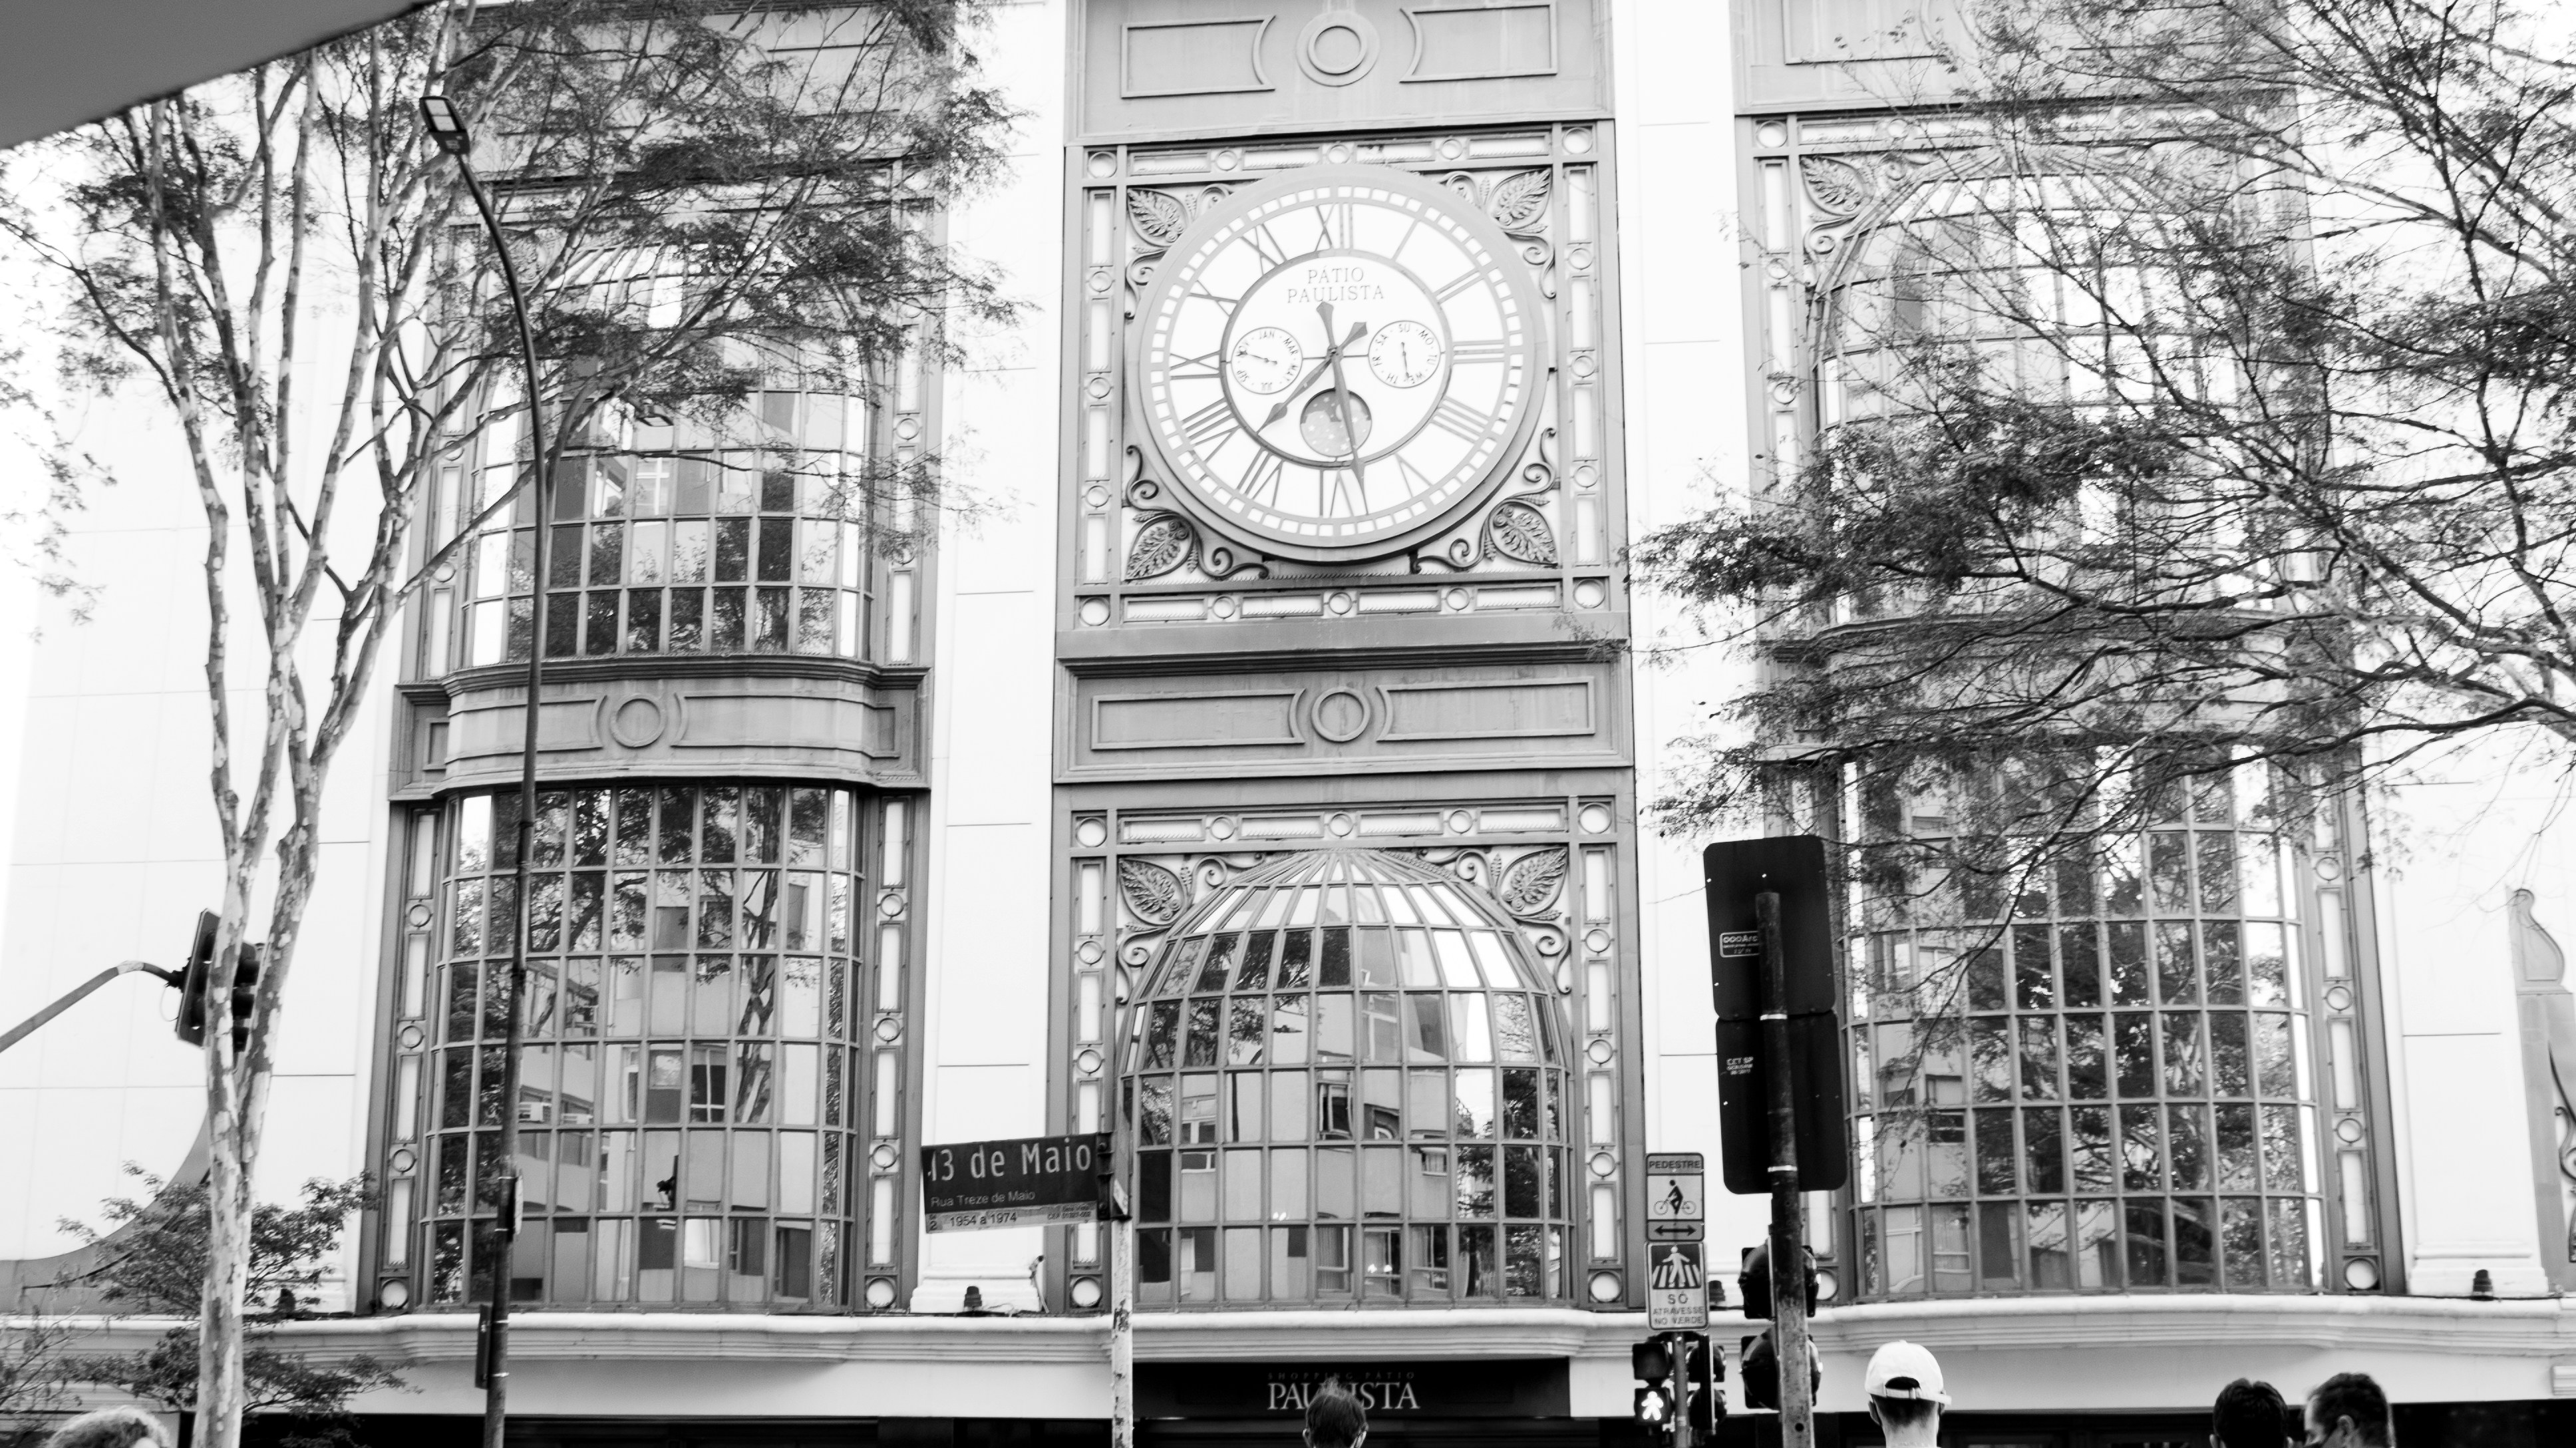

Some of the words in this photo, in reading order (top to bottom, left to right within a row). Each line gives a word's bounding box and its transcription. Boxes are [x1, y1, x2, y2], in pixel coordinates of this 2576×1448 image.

[1308, 266, 1364, 284] PÁTIO
[1287, 285, 1384, 303] PAULISTA
[1418, 329, 1434, 345] MO
[927, 1149, 954, 1181] 13
[970, 1145, 1005, 1179] de
[1021, 1137, 1092, 1176] Maio
[1649, 1160, 1701, 1169] PEDESTRE
[931, 1196, 954, 1207] Rua
[957, 1194, 989, 1205] Treze
[991, 1192, 1005, 1202] de
[1008, 1190, 1036, 1201] Maio
[930, 1220, 938, 1231] 2
[950, 1214, 977, 1227] 1954
[980, 1216, 987, 1225] a
[990, 1212, 1017, 1224] 1974
[1668, 1290, 1689, 1304] SÓ
[1653, 1306, 1704, 1316] ATRAVESSE
[1654, 1317, 1668, 1326] NO
[1672, 1316, 1703, 1325] VERDE
[1267, 1381, 1421, 1410] PAUISTA
